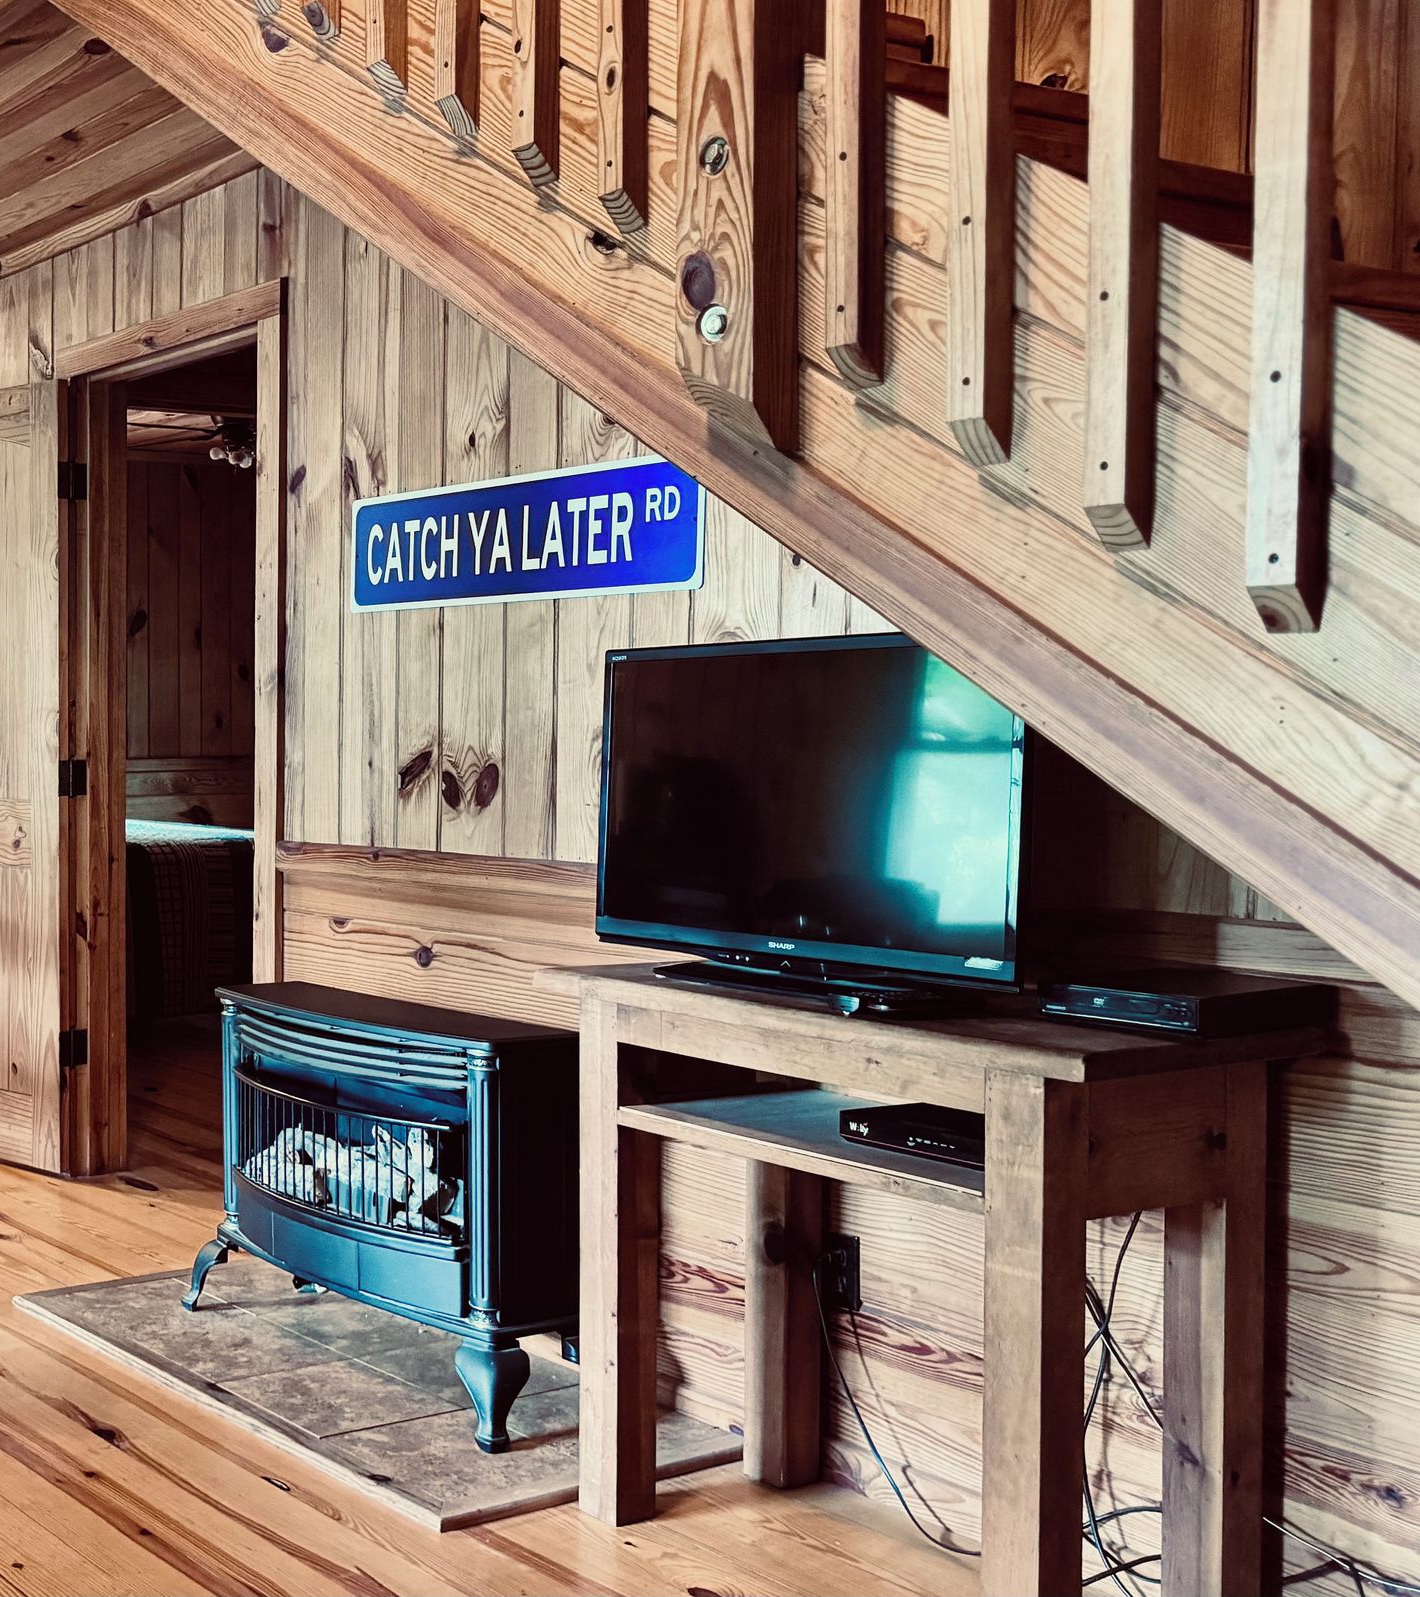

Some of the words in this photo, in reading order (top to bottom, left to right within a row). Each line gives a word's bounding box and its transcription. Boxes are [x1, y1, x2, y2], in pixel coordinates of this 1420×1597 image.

[367, 513, 460, 586] CATCH
[467, 508, 513, 576] YA
[521, 491, 635, 571] LATER
[645, 485, 682, 523] RD
[767, 941, 796, 950] SHARP
